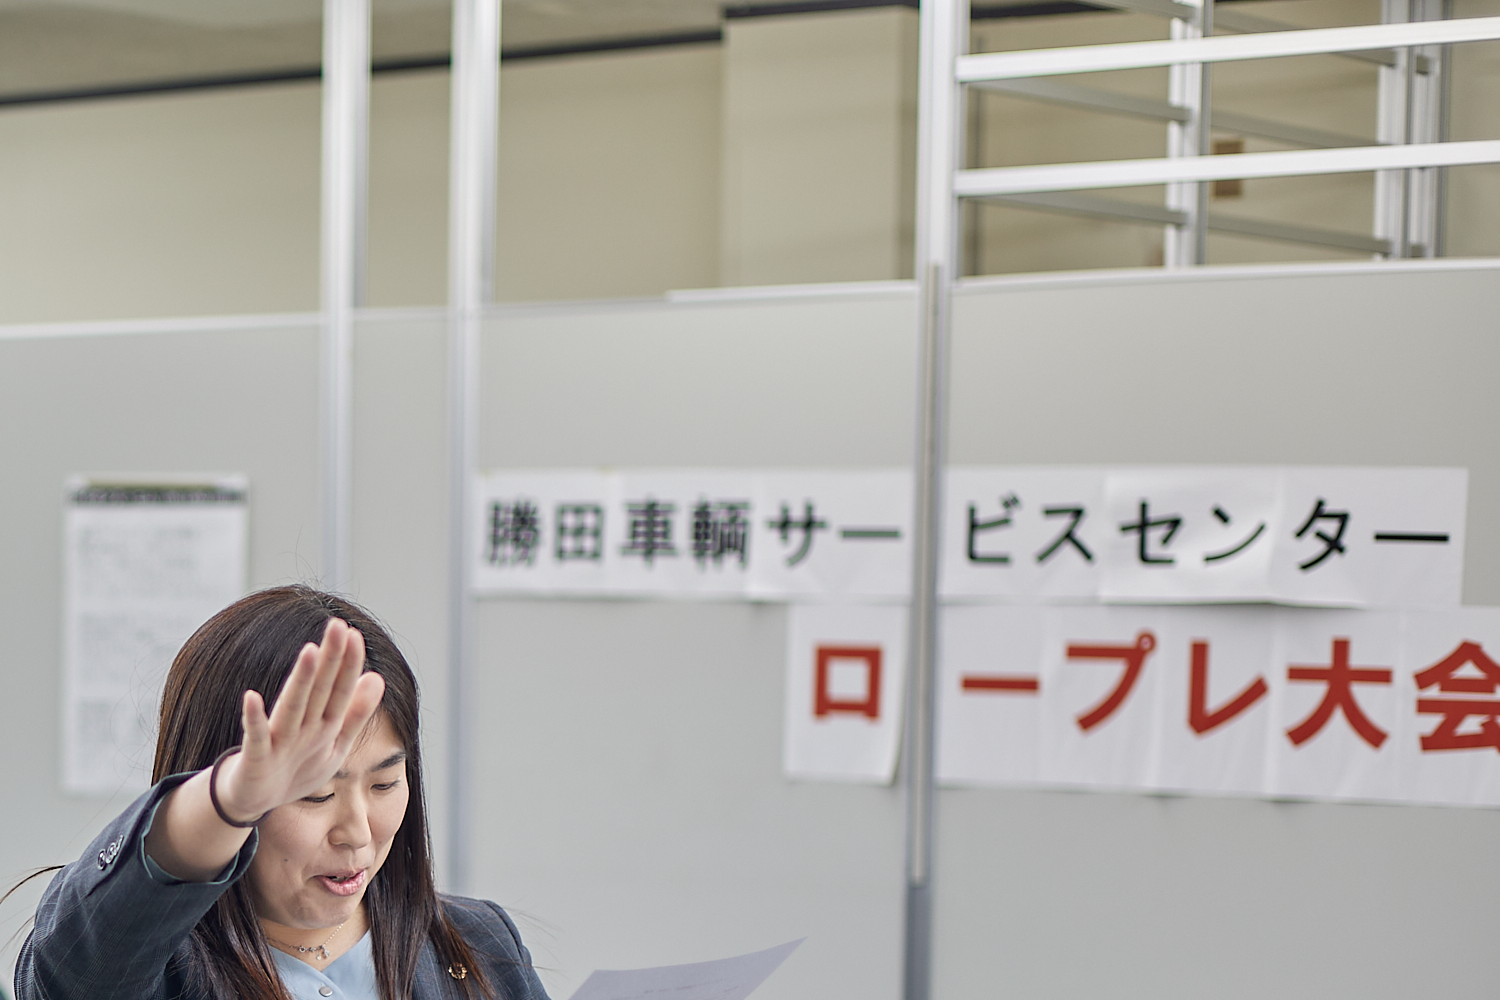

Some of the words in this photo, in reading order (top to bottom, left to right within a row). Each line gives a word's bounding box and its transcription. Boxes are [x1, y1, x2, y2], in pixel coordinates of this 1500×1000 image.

[812, 628, 1500, 754] ロープレ大会
